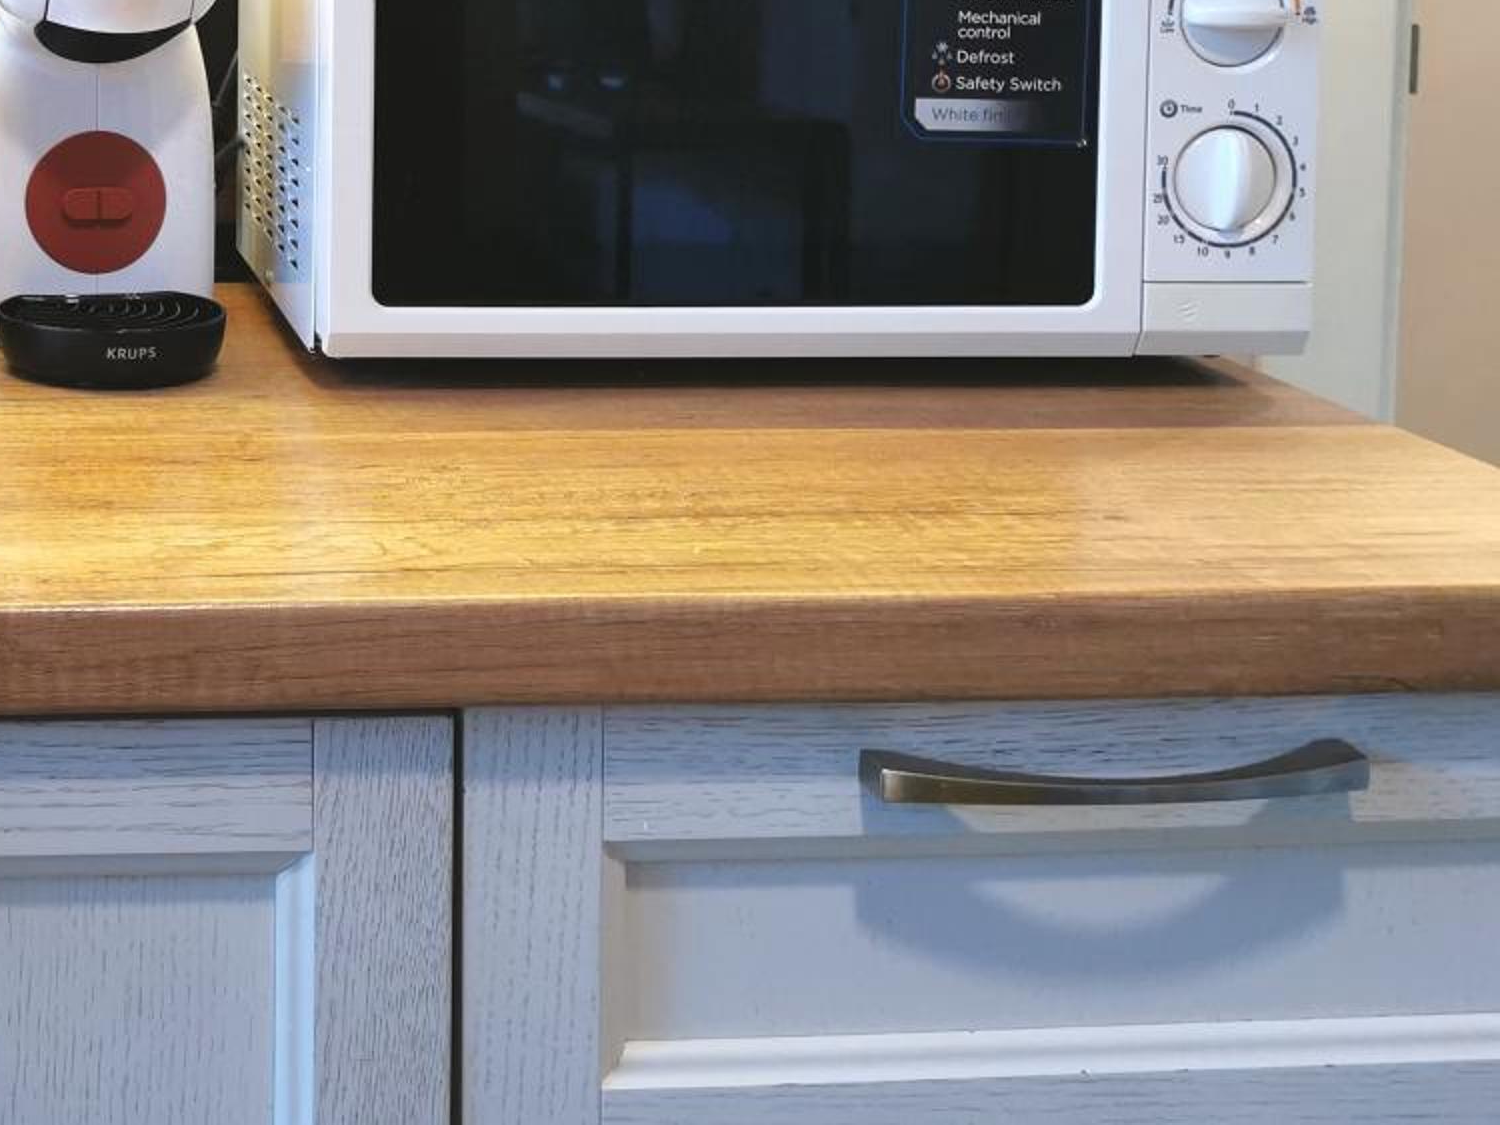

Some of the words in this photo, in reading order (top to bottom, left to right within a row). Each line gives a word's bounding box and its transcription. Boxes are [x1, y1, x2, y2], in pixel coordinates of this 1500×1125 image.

[958, 10, 1042, 26] Mechanical
[957, 27, 1011, 40] control
[957, 49, 1015, 65] Defrost
[955, 77, 1005, 94] Safety
[1009, 77, 1063, 92] Switch
[932, 107, 978, 122] White
[1180, 104, 1203, 114] Time
[107, 346, 157, 360] KRUPS
